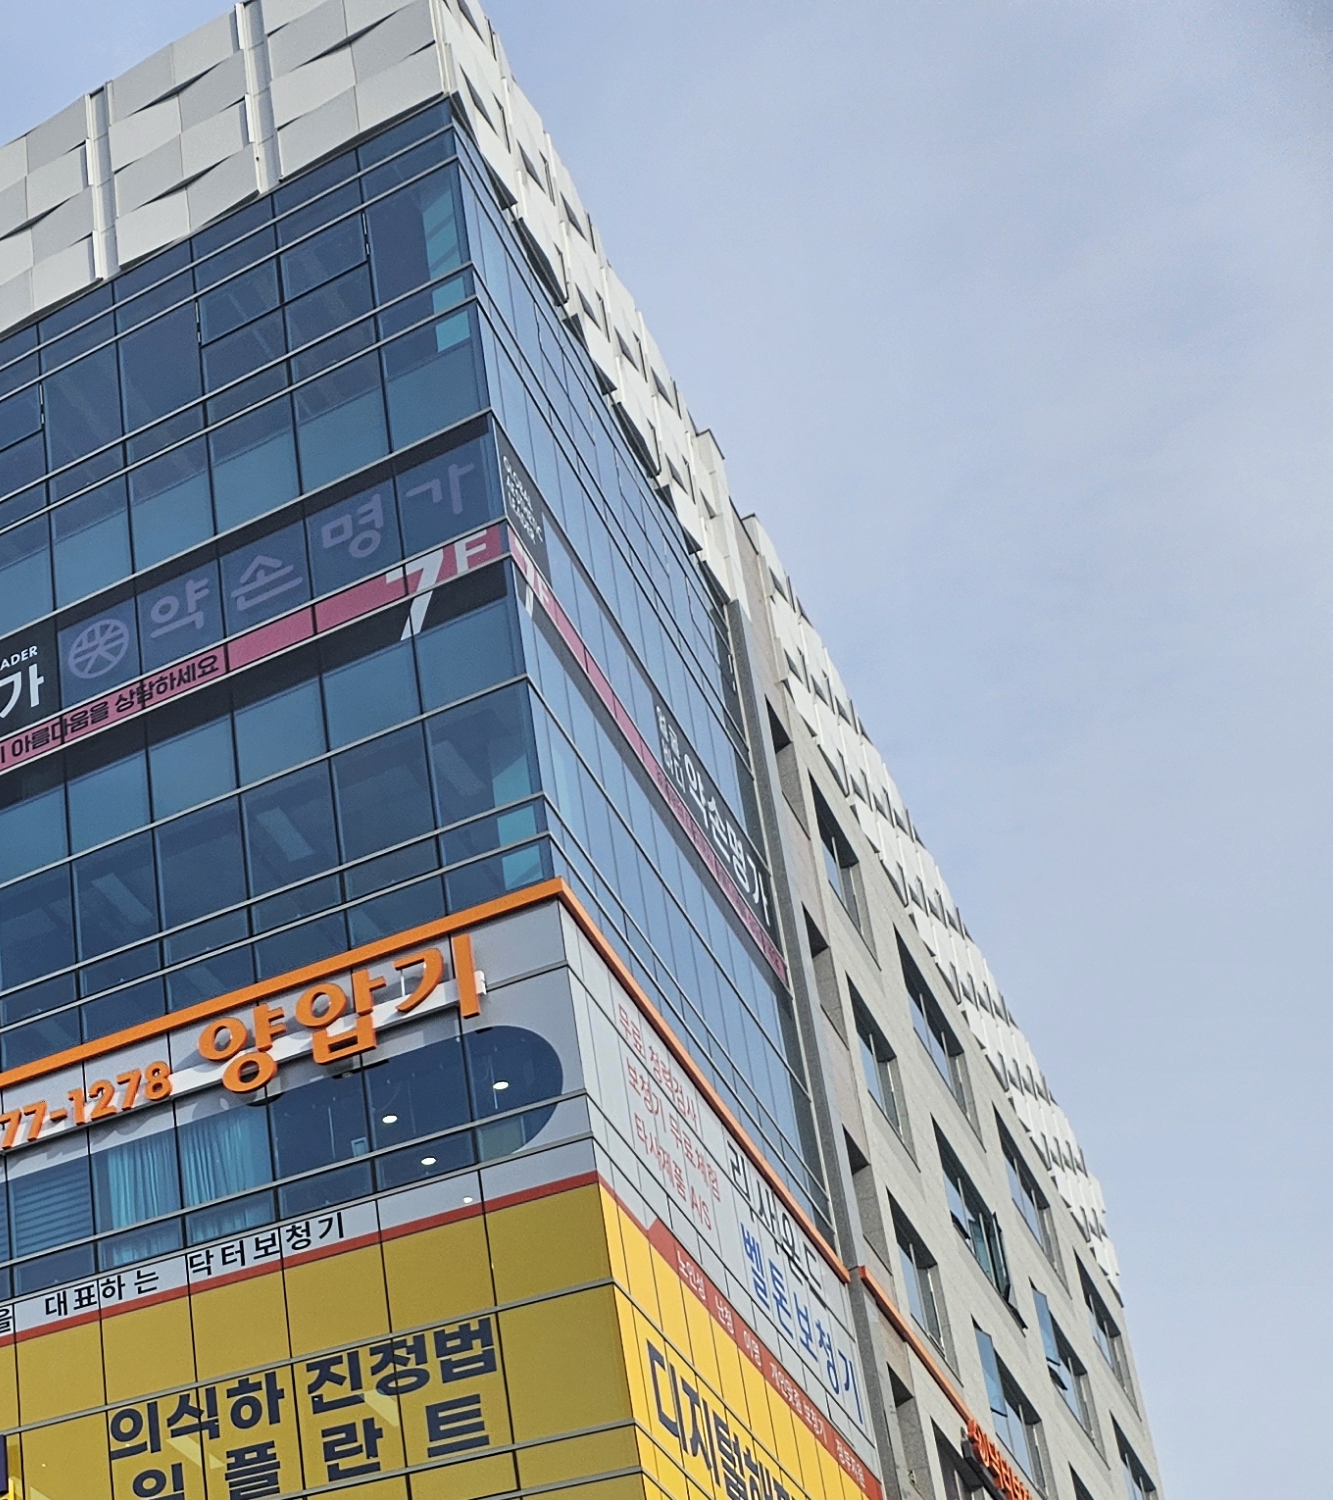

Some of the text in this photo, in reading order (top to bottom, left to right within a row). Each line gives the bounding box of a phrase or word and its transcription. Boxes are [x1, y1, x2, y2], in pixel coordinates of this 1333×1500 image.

[150, 461, 477, 641] 약손명가
[386, 538, 490, 641] 7F
[10, 700, 112, 759] 아름다움을
[114, 654, 221, 717] 상담하세요
[685, 753, 771, 927] 약손명가
[198, 932, 482, 1092] 양압기
[618, 1003, 647, 1060] 무료
[626, 1057, 667, 1133] 보청기
[44, 1269, 160, 1319] 대표하는
[187, 1215, 346, 1277] 닥터보청기
[306, 1317, 498, 1415] 진정법
